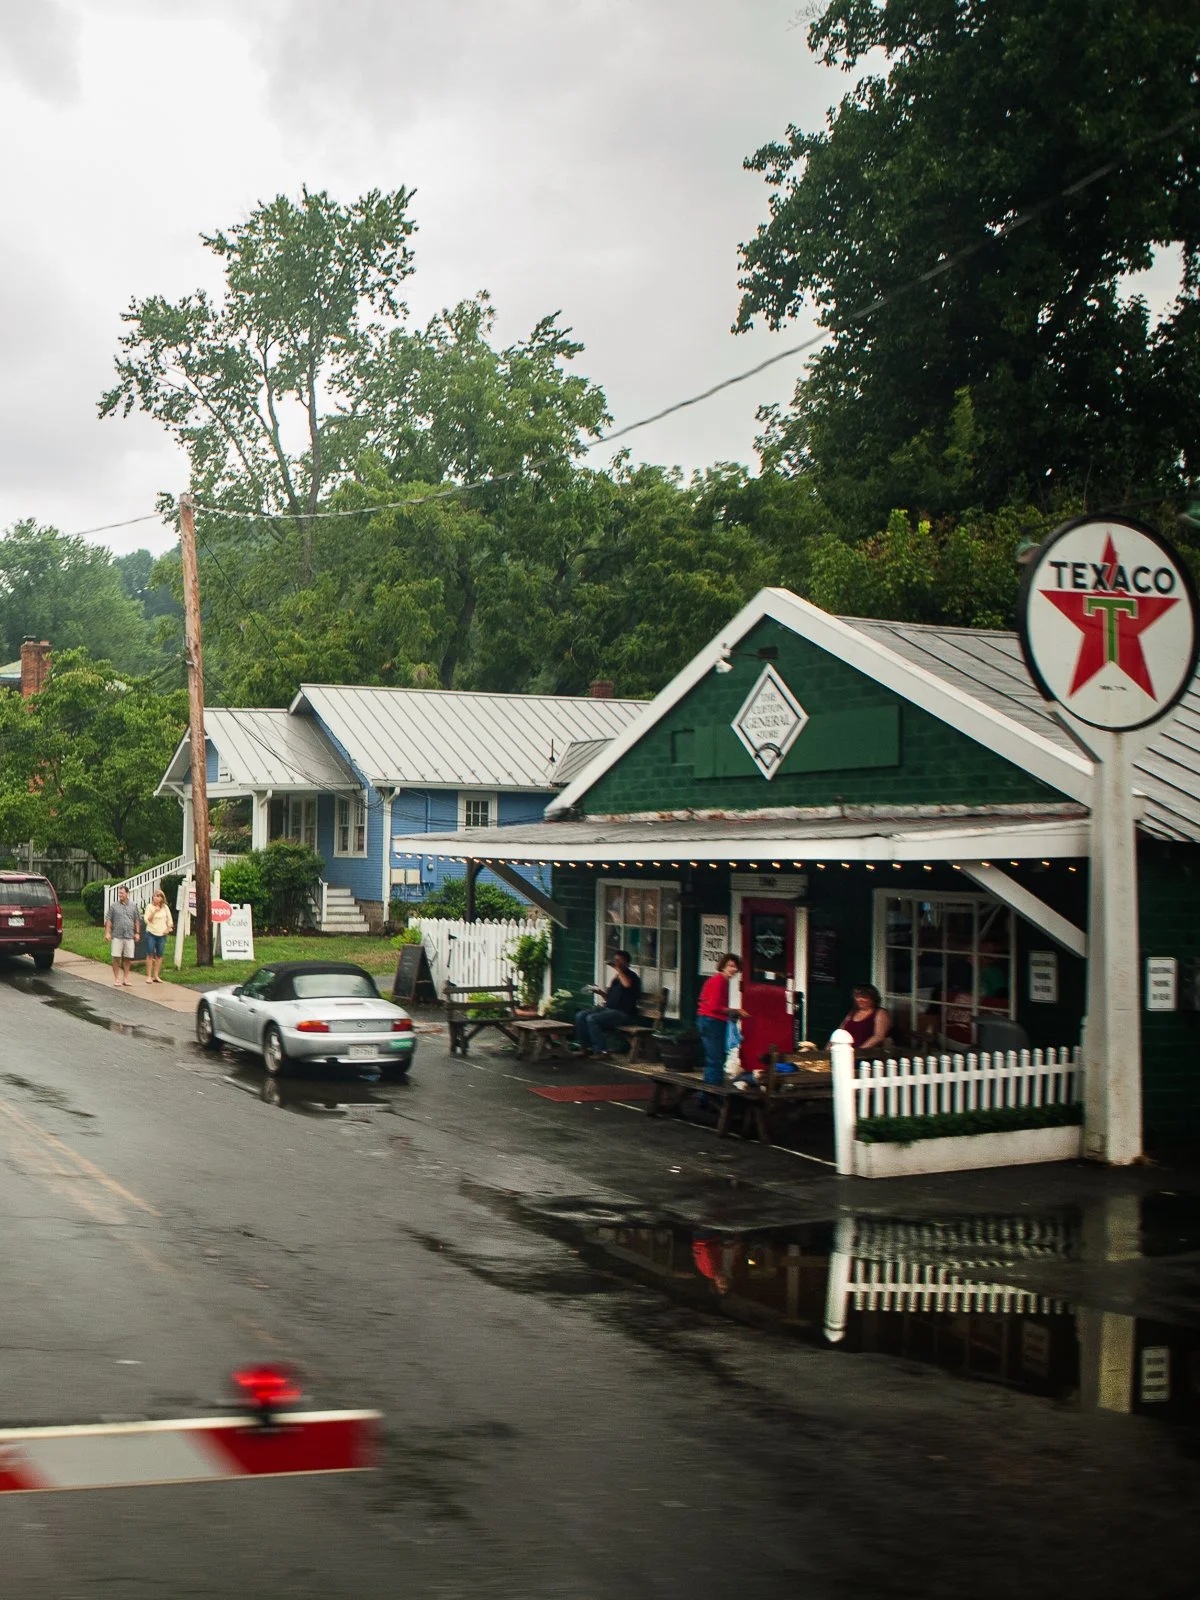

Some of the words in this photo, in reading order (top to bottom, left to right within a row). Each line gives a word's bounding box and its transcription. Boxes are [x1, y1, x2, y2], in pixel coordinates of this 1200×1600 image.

[1049, 560, 1176, 594] TEXACO
[1083, 595, 1139, 664] T
[745, 714, 791, 729] GENERAL
[704, 924, 727, 936] GOOD
[225, 939, 250, 947] OPEN
[705, 937, 723, 949] HOT
